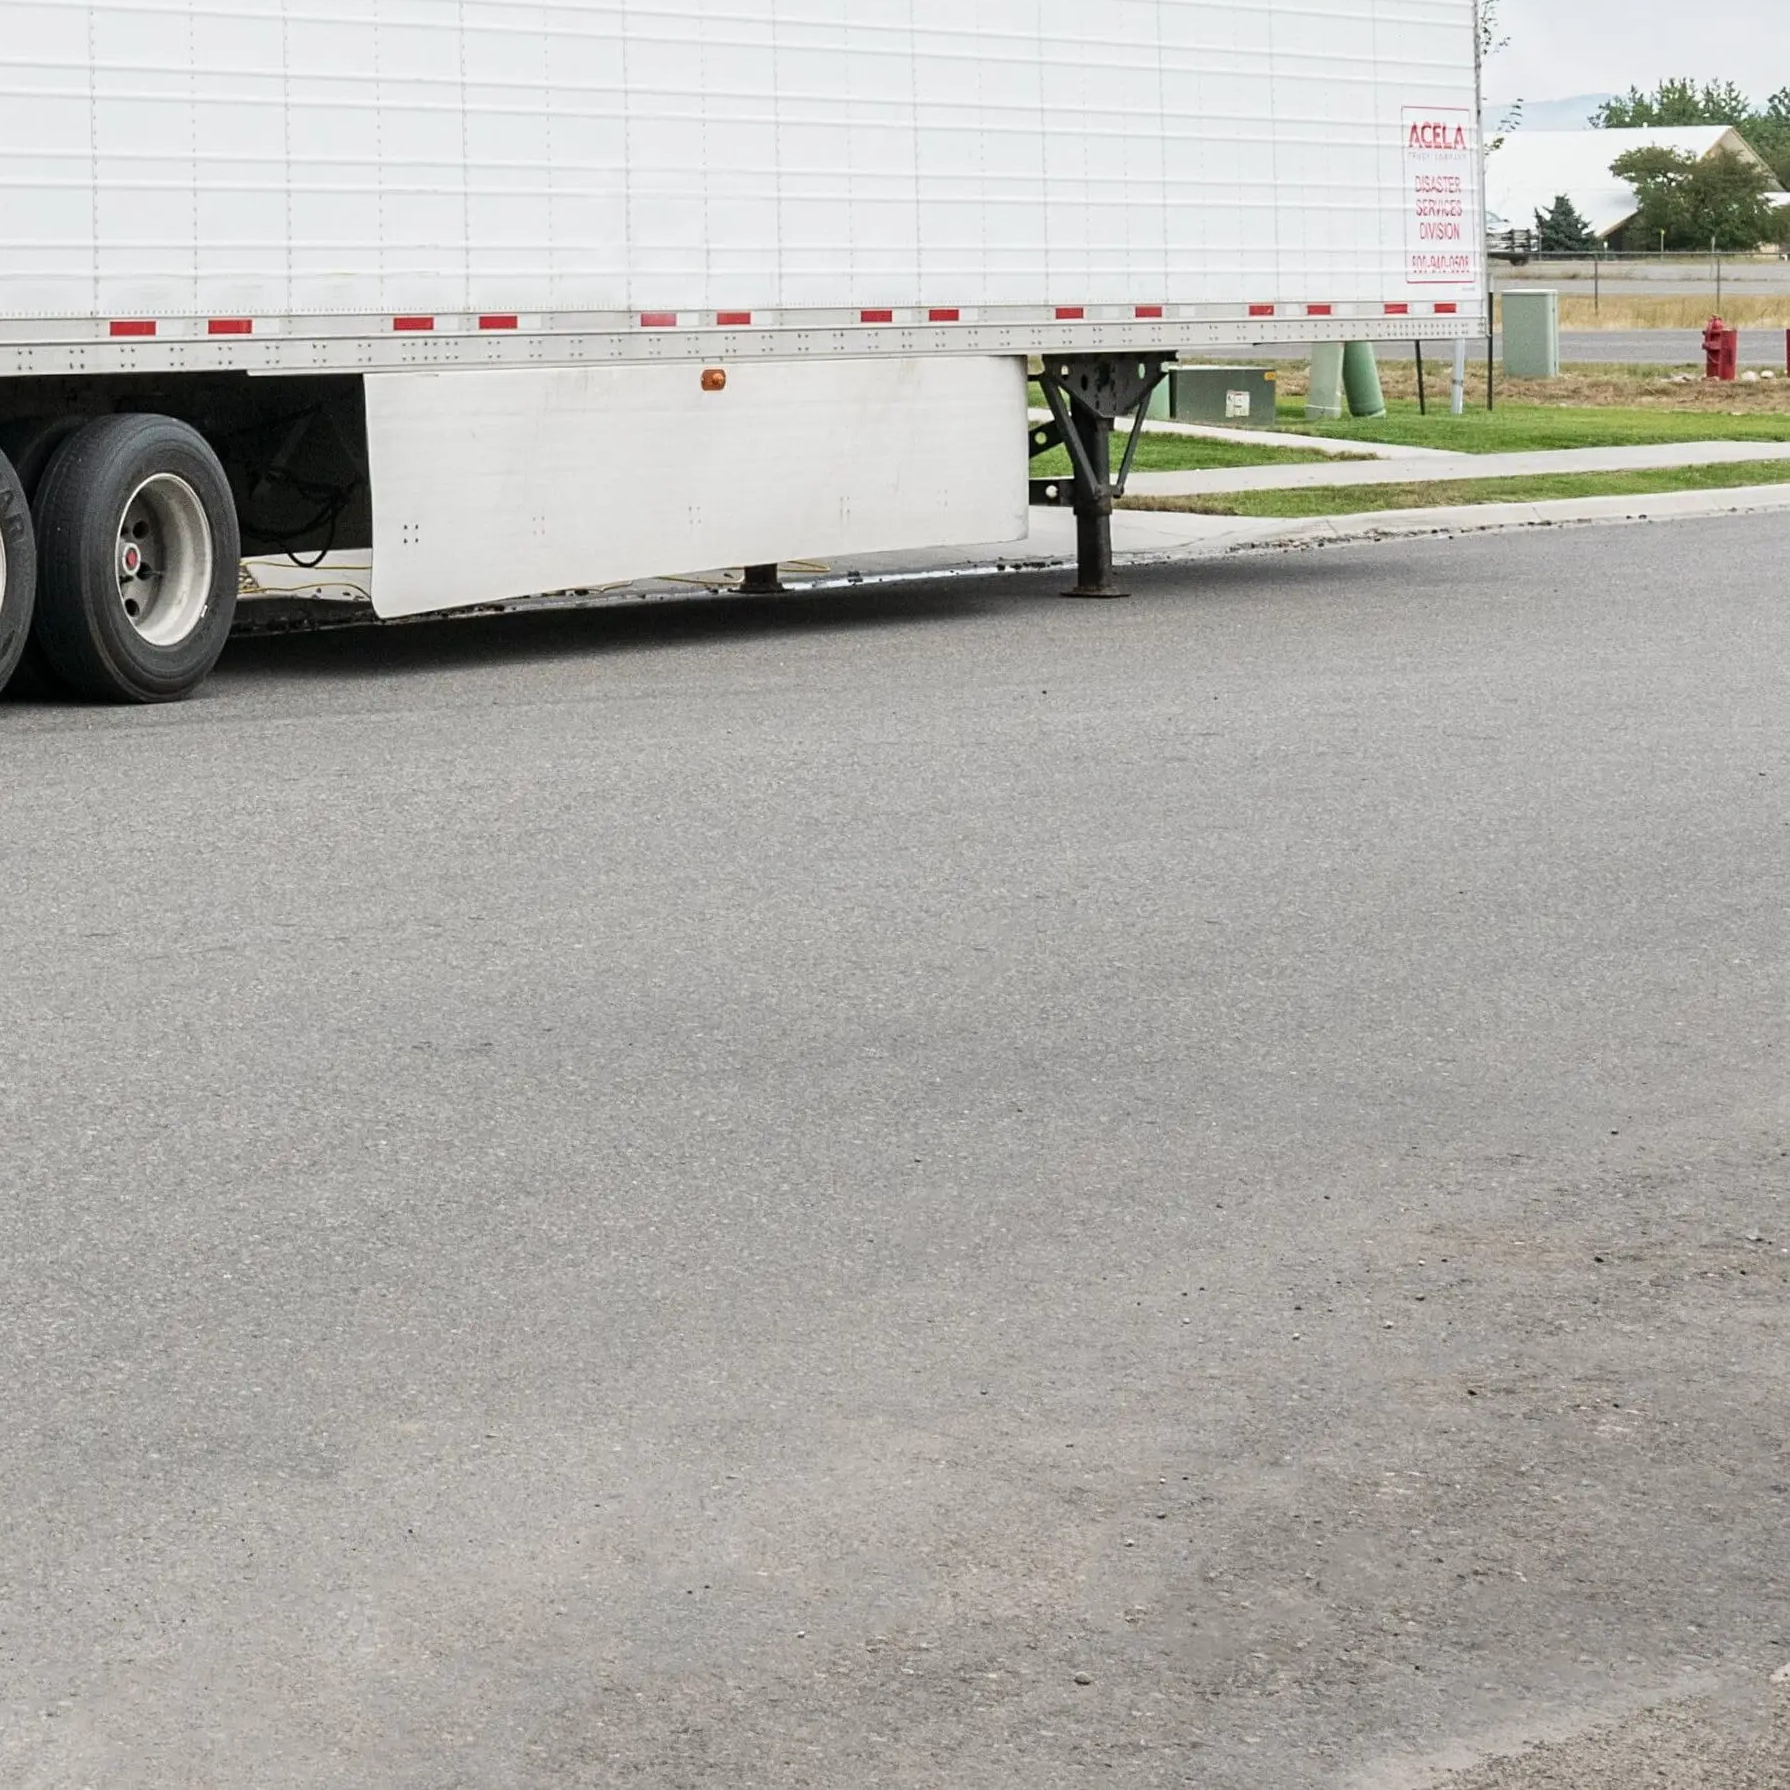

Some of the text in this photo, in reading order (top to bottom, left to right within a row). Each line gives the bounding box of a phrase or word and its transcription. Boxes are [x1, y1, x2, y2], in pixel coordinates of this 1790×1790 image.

[1409, 121, 1466, 150] ACELA
[1415, 175, 1462, 193] DISASTER
[1415, 198, 1462, 217] SERVICES
[1419, 222, 1461, 241] DIVISION
